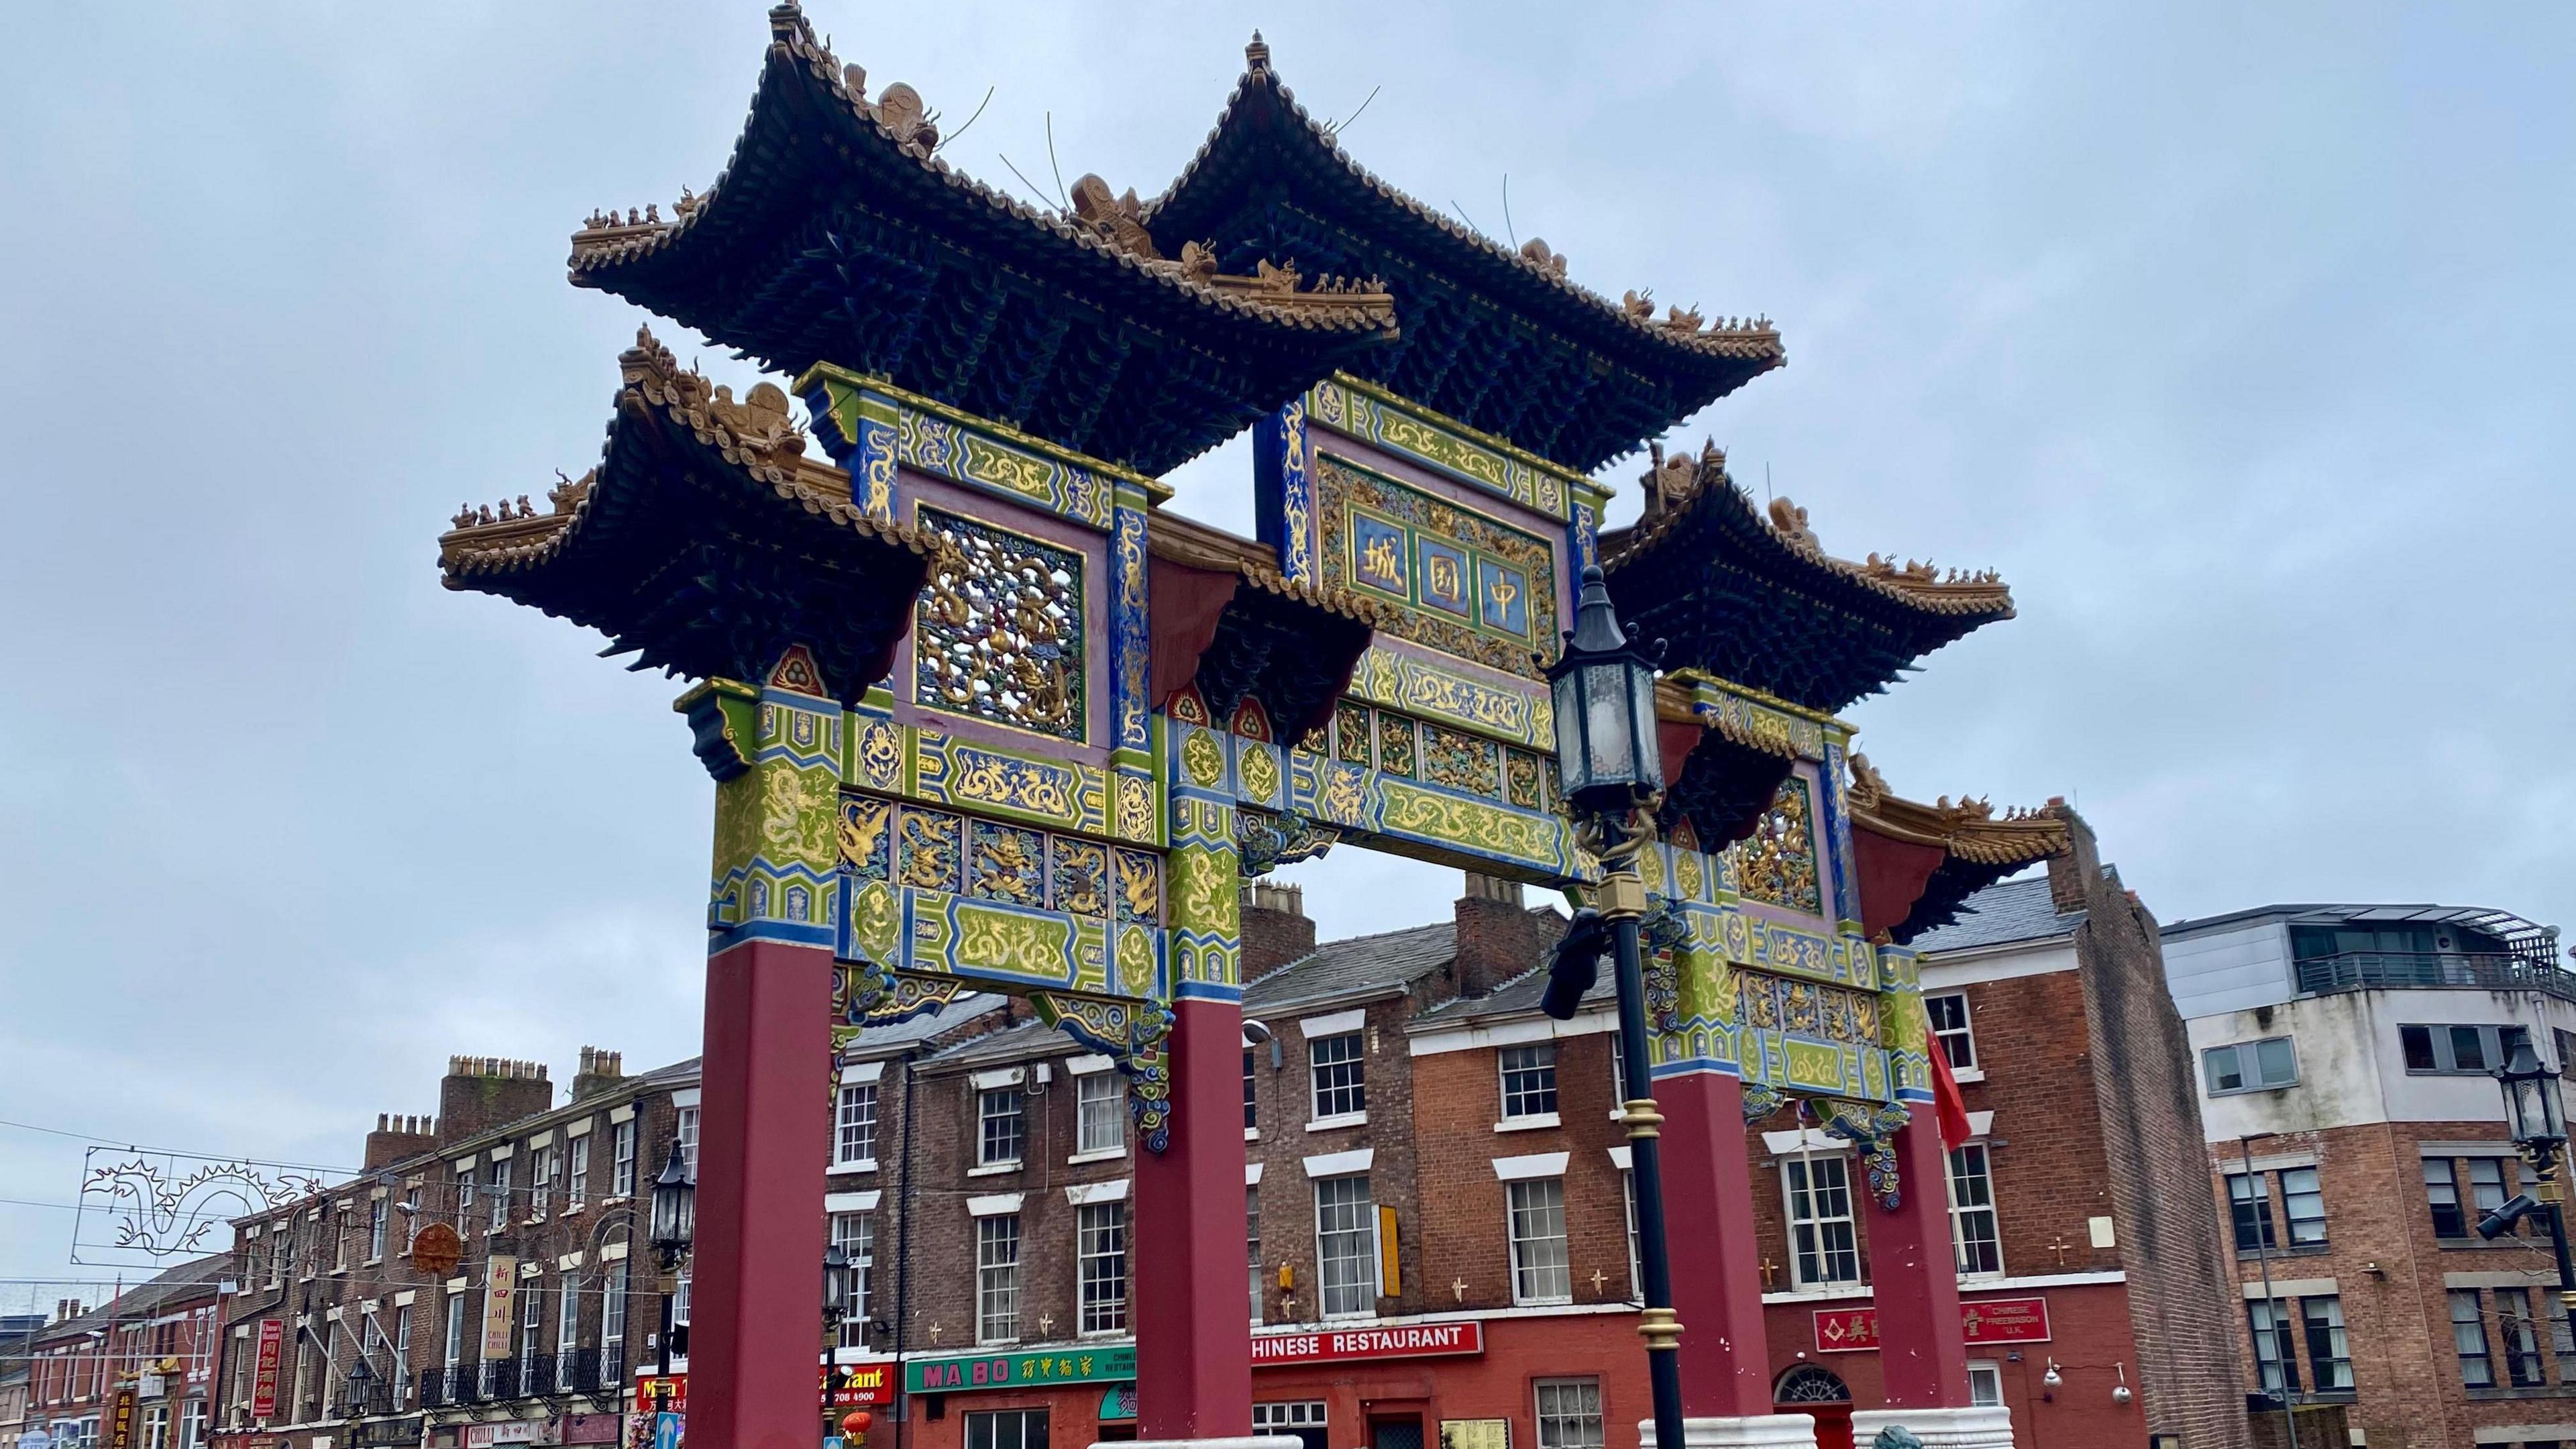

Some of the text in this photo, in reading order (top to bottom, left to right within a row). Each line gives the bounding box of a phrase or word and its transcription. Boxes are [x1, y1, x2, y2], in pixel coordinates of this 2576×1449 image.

[1992, 1306, 2031, 1316] CHINESE
[1986, 1316, 2039, 1326] FREEMASON
[488, 1331, 508, 1339] CHILLI
[488, 1342, 508, 1350] CHILLI
[1252, 1327, 1462, 1358] HINESE RESTAURANT
[1114, 1352, 1136, 1361] CHINES
[1105, 1362, 1136, 1373] RESTAUR
[922, 1358, 1010, 1389] MA BO
[835, 1393, 851, 1402] 708
[853, 1391, 875, 1401] 4900
